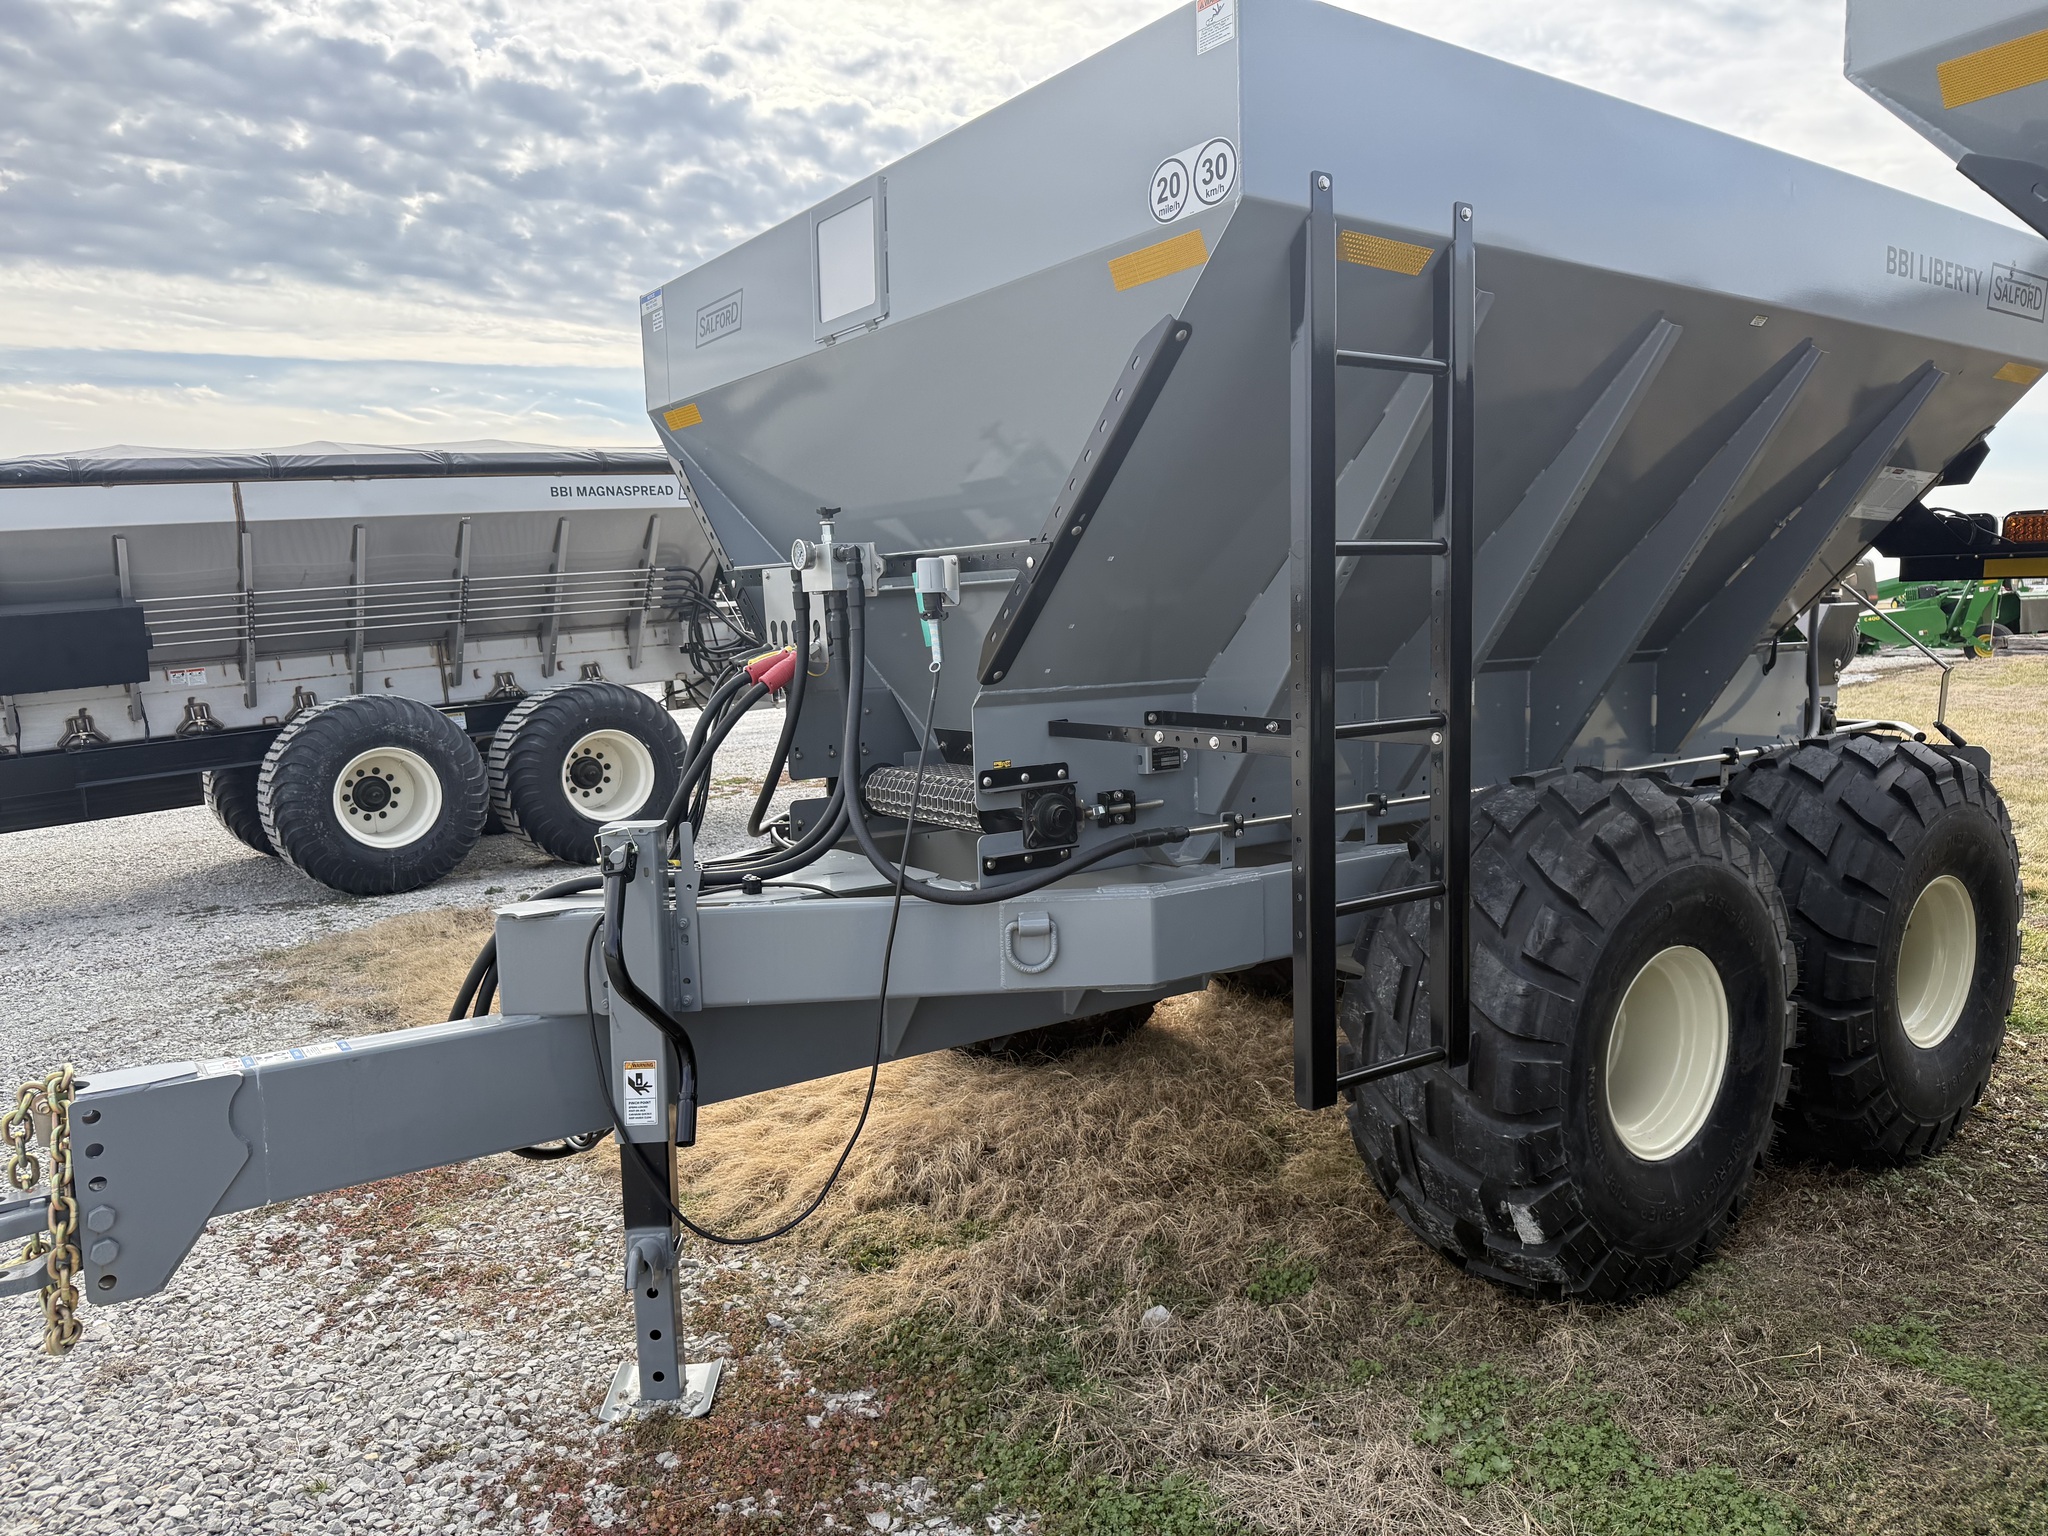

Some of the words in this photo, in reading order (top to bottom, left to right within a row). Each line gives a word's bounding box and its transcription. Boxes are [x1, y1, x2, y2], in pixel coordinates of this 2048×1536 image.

[1201, 152, 1228, 186] 30
[1156, 171, 1181, 205] 20
[1205, 183, 1225, 199] km/h
[1158, 200, 1180, 217] mile/h
[1886, 245, 1914, 279] BBI
[1919, 254, 1983, 296] LIBERTY
[1993, 275, 2043, 310] SALFORD
[699, 301, 739, 338] SALFORD
[550, 486, 573, 498] BBI
[576, 485, 674, 497] MAGNASPREAD
